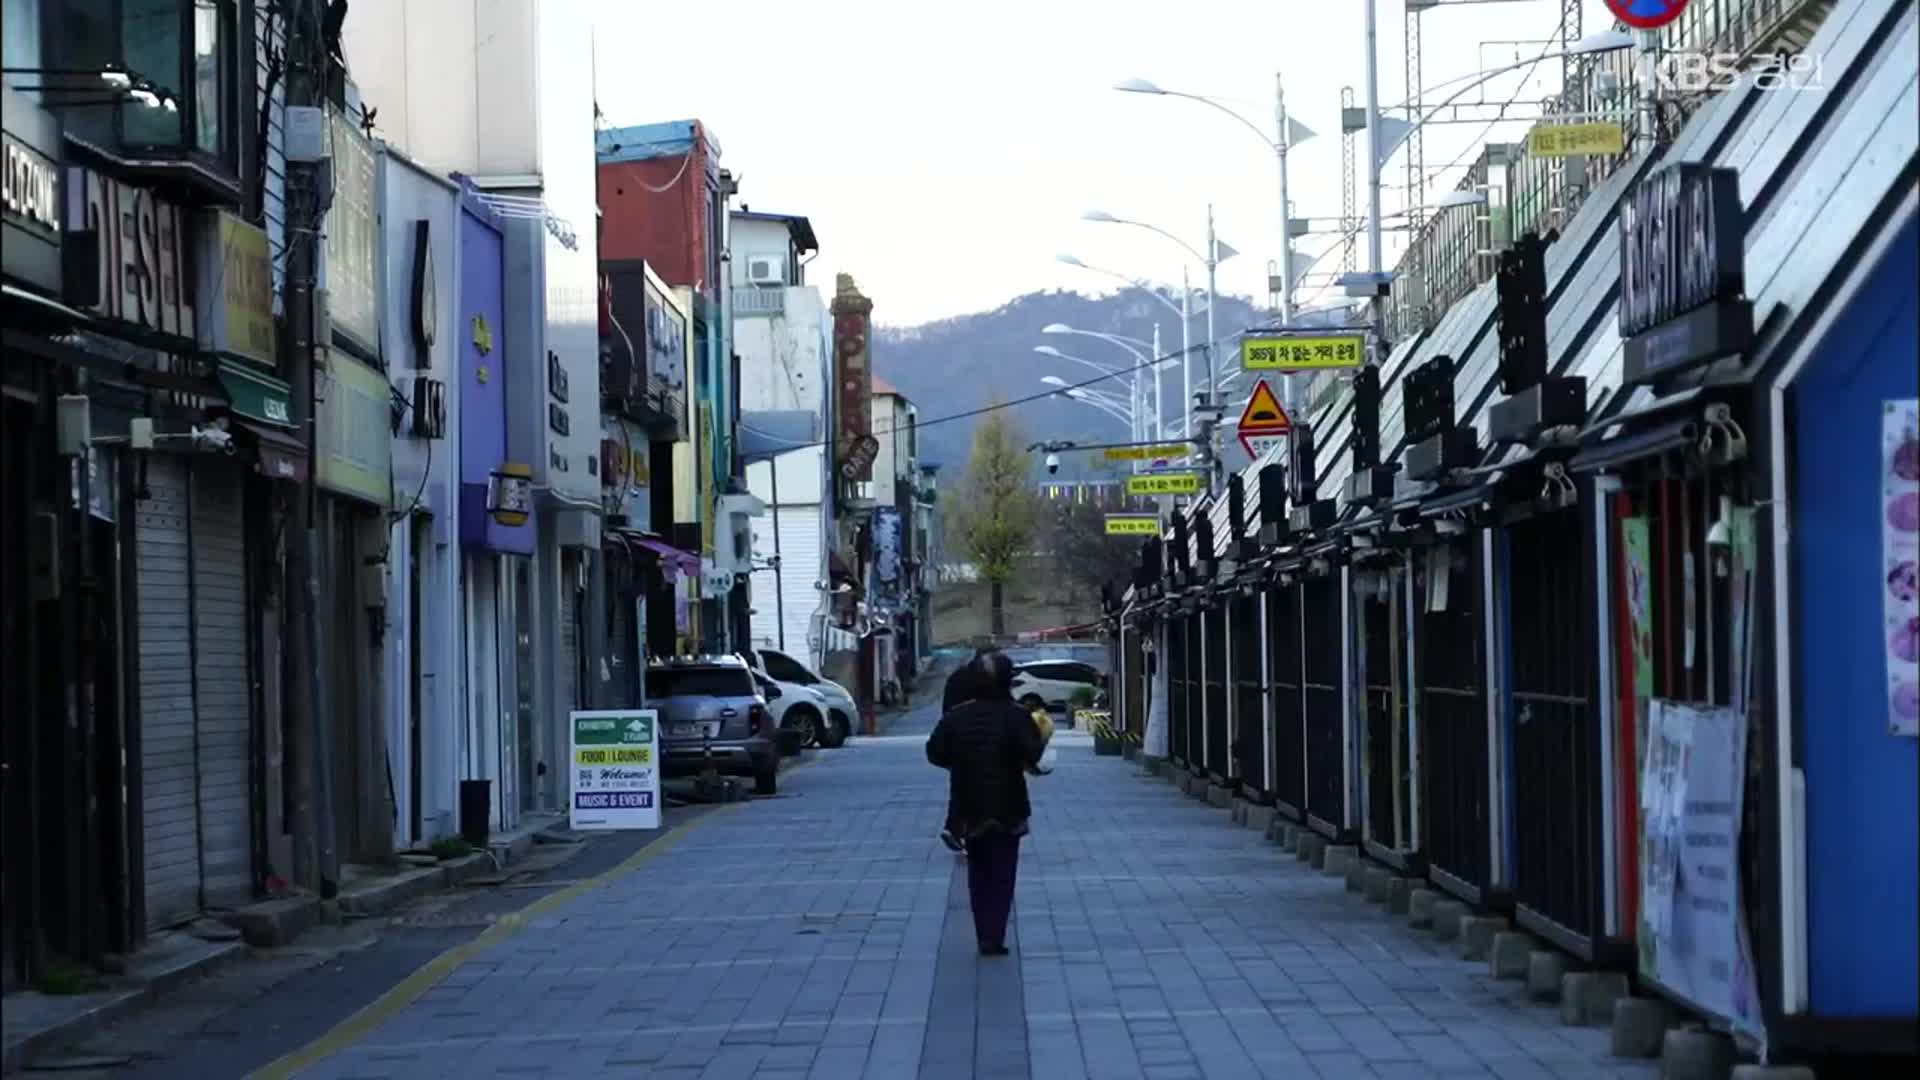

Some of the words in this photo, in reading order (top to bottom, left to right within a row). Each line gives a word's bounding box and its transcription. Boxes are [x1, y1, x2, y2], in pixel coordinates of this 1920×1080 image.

[86, 168, 194, 338] DIESEL
[1249, 347, 1276, 362] 365일
[1279, 346, 1289, 360] 차
[1291, 345, 1311, 362] 없는
[1314, 345, 1333, 361] 거리
[582, 751, 606, 762] FOOD
[612, 749, 649, 762] LOUNGE
[578, 794, 609, 807] MUSIC
[619, 793, 649, 806] EVENT
